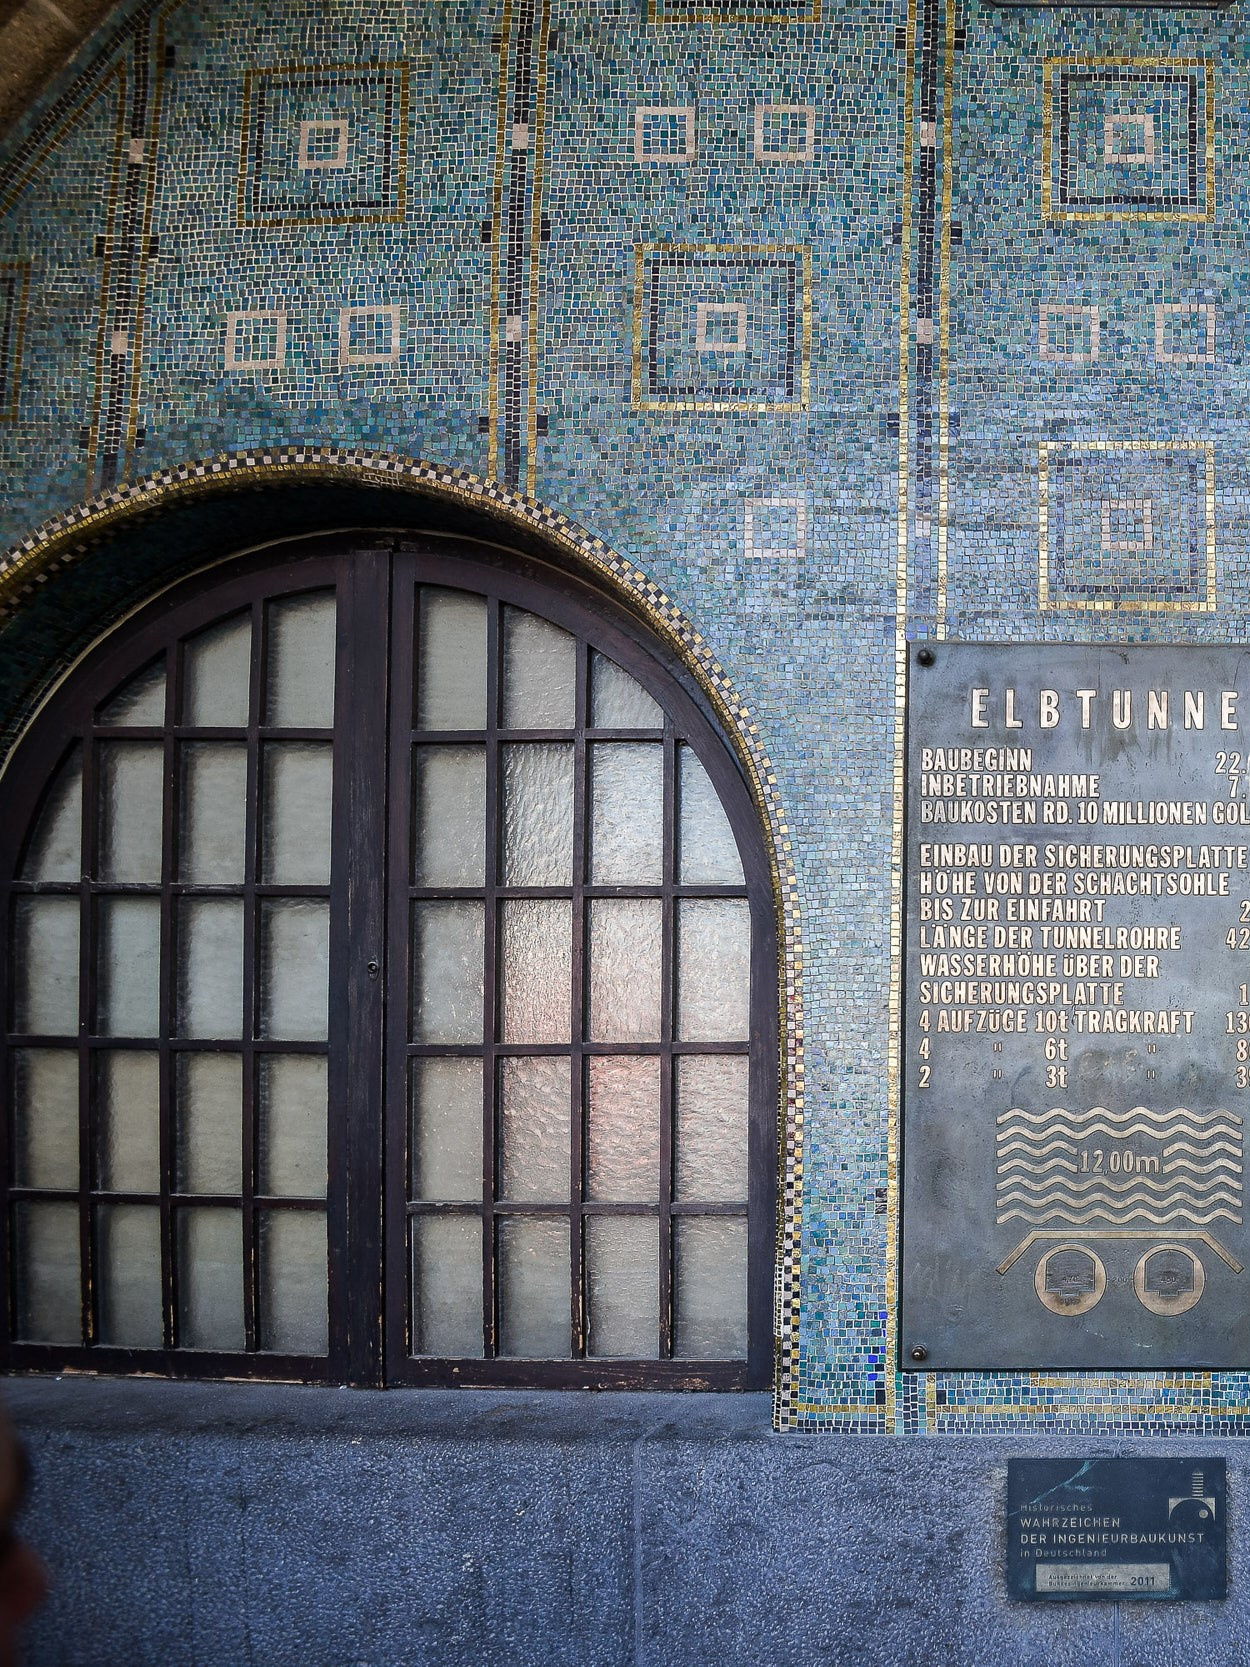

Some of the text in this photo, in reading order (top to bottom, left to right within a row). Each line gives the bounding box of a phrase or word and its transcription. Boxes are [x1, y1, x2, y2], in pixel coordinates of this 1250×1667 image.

[921, 748, 1032, 772] BAUBEGINN
[921, 774, 1100, 798] INBETRIEBNAHME
[920, 800, 1037, 825] BAUKOSTEN
[1043, 801, 1073, 825] RD.
[1078, 801, 1098, 825] 10
[1103, 801, 1208, 825] MILLIONEN
[919, 844, 994, 869] EINBAU
[999, 844, 1039, 869] DER
[1044, 845, 1248, 869] SICHERUNGSPLATTE
[919, 868, 1230, 896] HÖHE VON DER SCHACHTSOHLE
[919, 898, 954, 922] BIS
[960, 898, 999, 922] ZUR
[1007, 898, 1106, 923] EINFAHRT
[919, 923, 988, 950] LÄNGE
[993, 926, 1033, 950] DER
[1040, 926, 1181, 950] TUNNELROHRE
[919, 950, 1160, 978] WASSERHÖHE ÜBER DER
[919, 981, 1124, 1006] SICHERUNGSPLATTE
[918, 1010, 931, 1032] 4
[937, 1008, 1027, 1033] AUFZÜGE
[1035, 1010, 1069, 1034] 10t
[1074, 1010, 1195, 1034] TRAGKRAFT
[918, 1037, 931, 1060] 4
[1044, 1038, 1068, 1061] 6t
[918, 1065, 931, 1088] 2
[1047, 1065, 1068, 1089] 3t
[1020, 1503, 1093, 1512] Historisches
[1020, 1517, 1121, 1528] WAHRZEICHEN
[1020, 1533, 1205, 1544] DER INGENIEURBAUKUNST
[1020, 1549, 1107, 1558] in Deutschland
[1130, 1576, 1156, 1586] 2011
